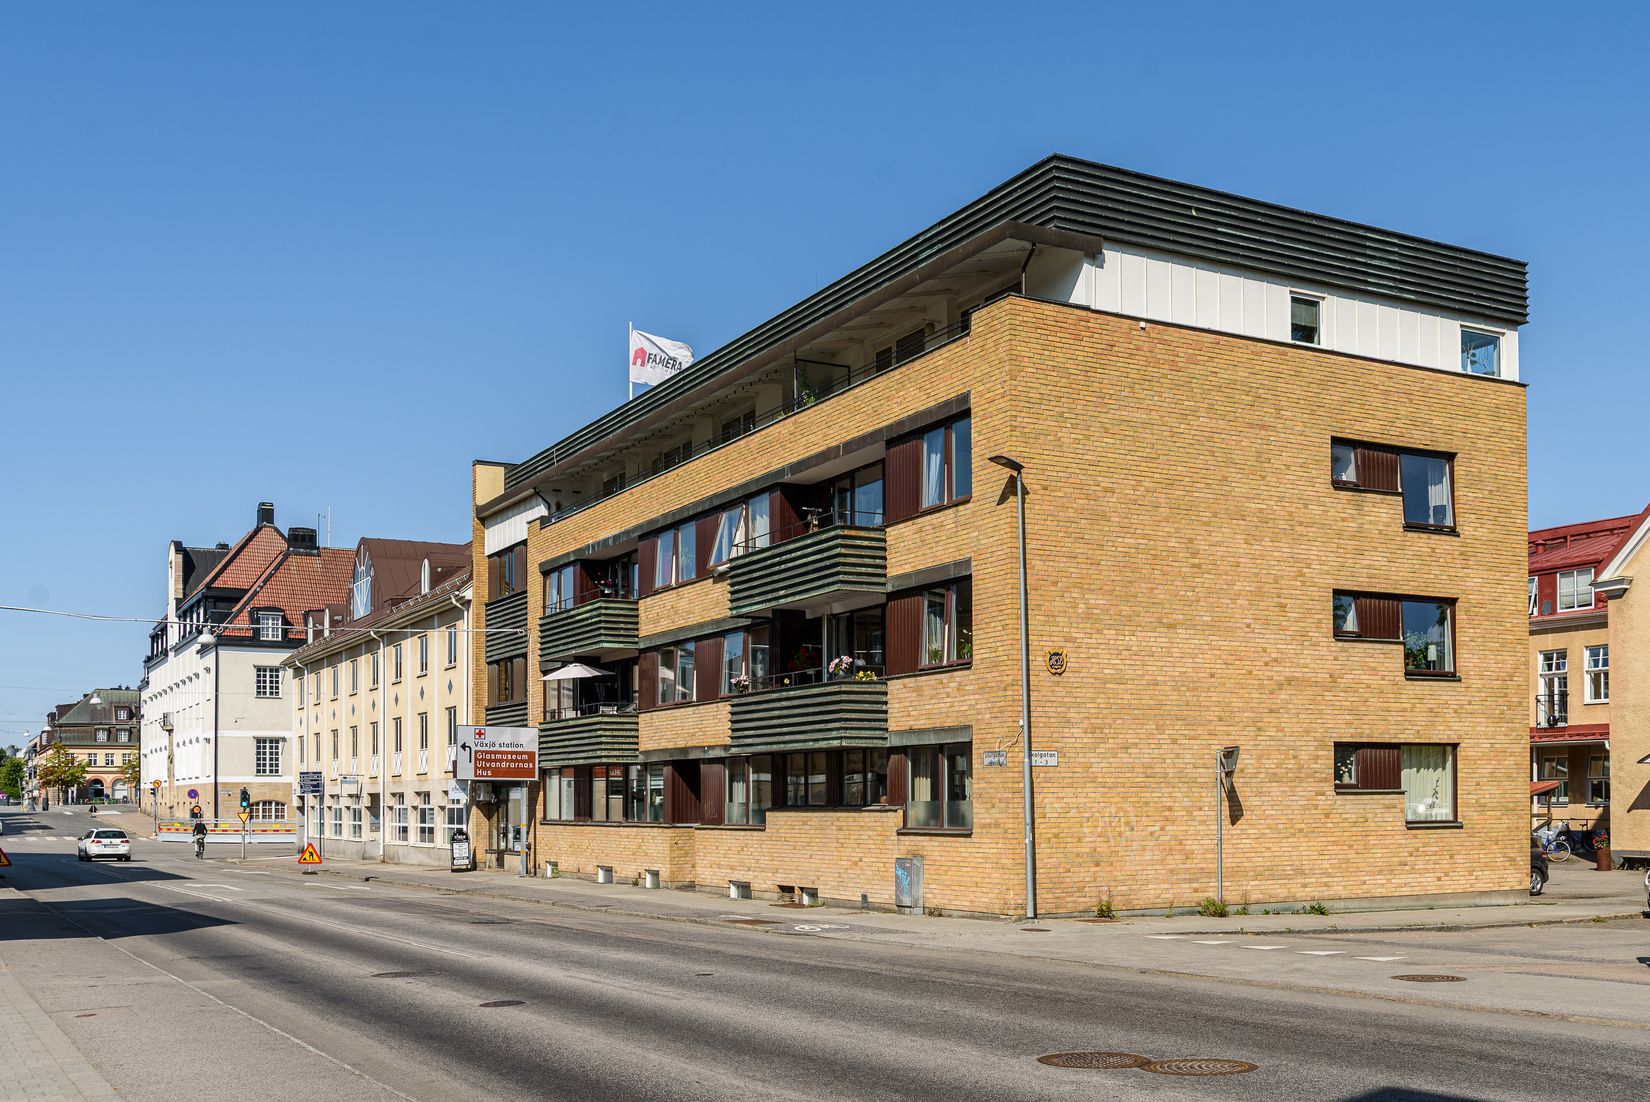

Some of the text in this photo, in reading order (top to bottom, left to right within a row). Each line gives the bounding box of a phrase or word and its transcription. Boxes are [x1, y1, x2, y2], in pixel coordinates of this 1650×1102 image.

[473, 741, 496, 749] Växjö
[476, 752, 528, 760] Glasmuseum
[476, 760, 533, 768] Utvandrarnas
